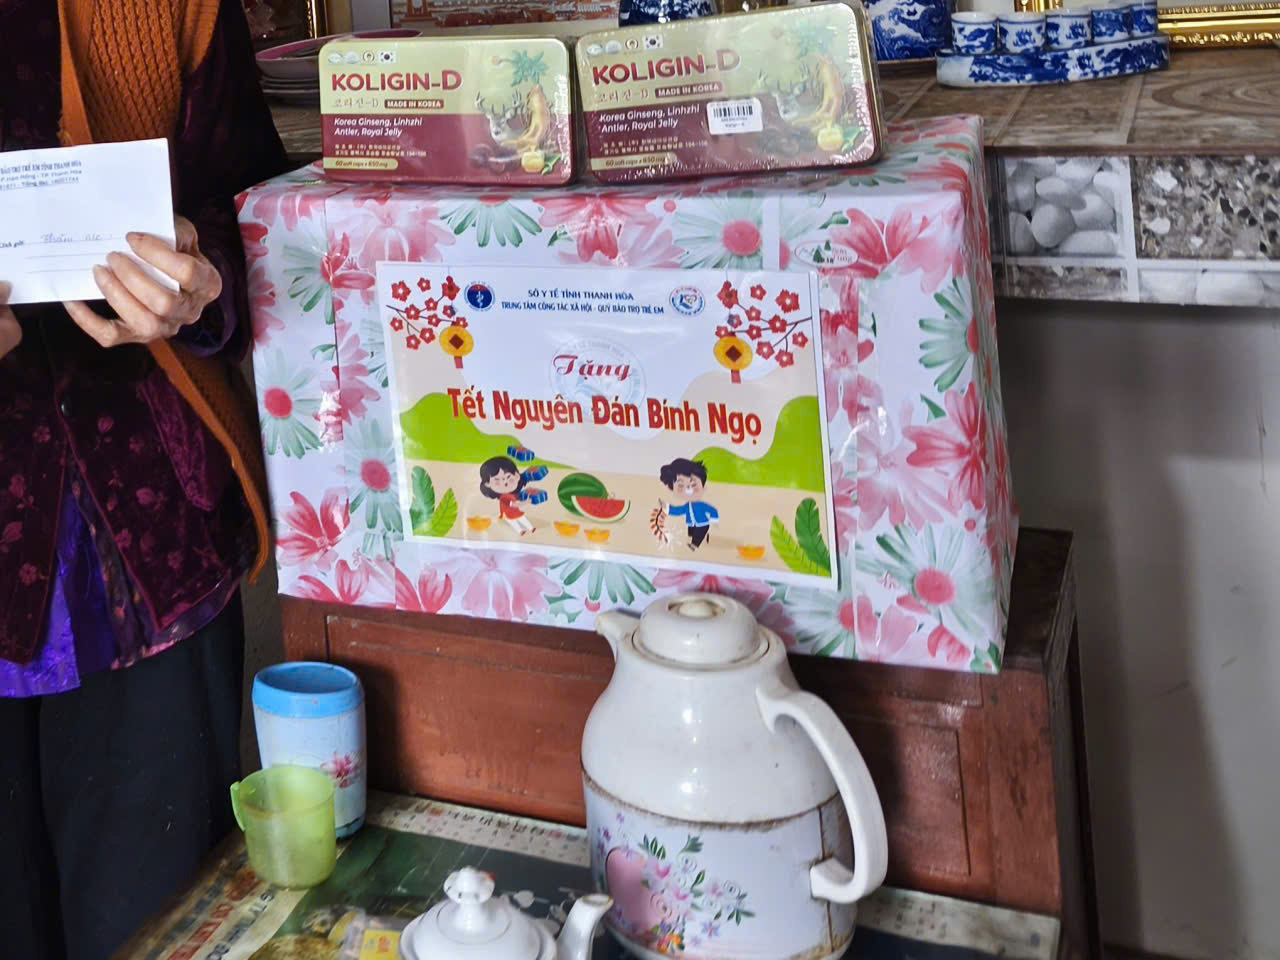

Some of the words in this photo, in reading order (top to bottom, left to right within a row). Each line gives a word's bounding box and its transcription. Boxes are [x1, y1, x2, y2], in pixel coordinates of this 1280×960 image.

[592, 49, 740, 85] KOLIGIN-D
[332, 70, 462, 92] KOLIGIN-D
[658, 87, 679, 97] MADE
[682, 86, 691, 94] IN
[692, 84, 719, 93] KOREA
[599, 113, 625, 123] Korea
[627, 109, 666, 121] Ginseng,
[667, 103, 700, 117] Linhzhi
[334, 117, 357, 126] Korea
[358, 117, 392, 127] Ginseng,
[393, 117, 423, 126] Linhzhi
[601, 122, 630, 133] Antler,
[631, 120, 656, 132] Royal
[658, 117, 678, 128] Jelly
[334, 128, 360, 137] Antler,
[361, 128, 383, 137] Royal
[384, 128, 403, 137] Jelly
[528, 288, 540, 298] SỞ
[541, 290, 548, 298] Y
[549, 288, 559, 298] TẾ
[561, 288, 581, 299] TỈNH
[583, 291, 613, 300] THANH
[501, 301, 522, 310] TRUNG
[523, 300, 537, 310] TÂM
[538, 301, 556, 311] CÔNG
[557, 302, 569, 311] TÁC
[570, 302, 580, 312] XÃ
[580, 302, 593, 313] HỘI
[612, 302, 626, 313] BẢO
[653, 306, 665, 314] EM
[553, 354, 631, 382] Tặng
[446, 385, 486, 421] Tết
[493, 390, 583, 433] Nguyên
[592, 394, 640, 428] Đán
[646, 397, 700, 433] Bính
[708, 402, 763, 445] Ngọ
